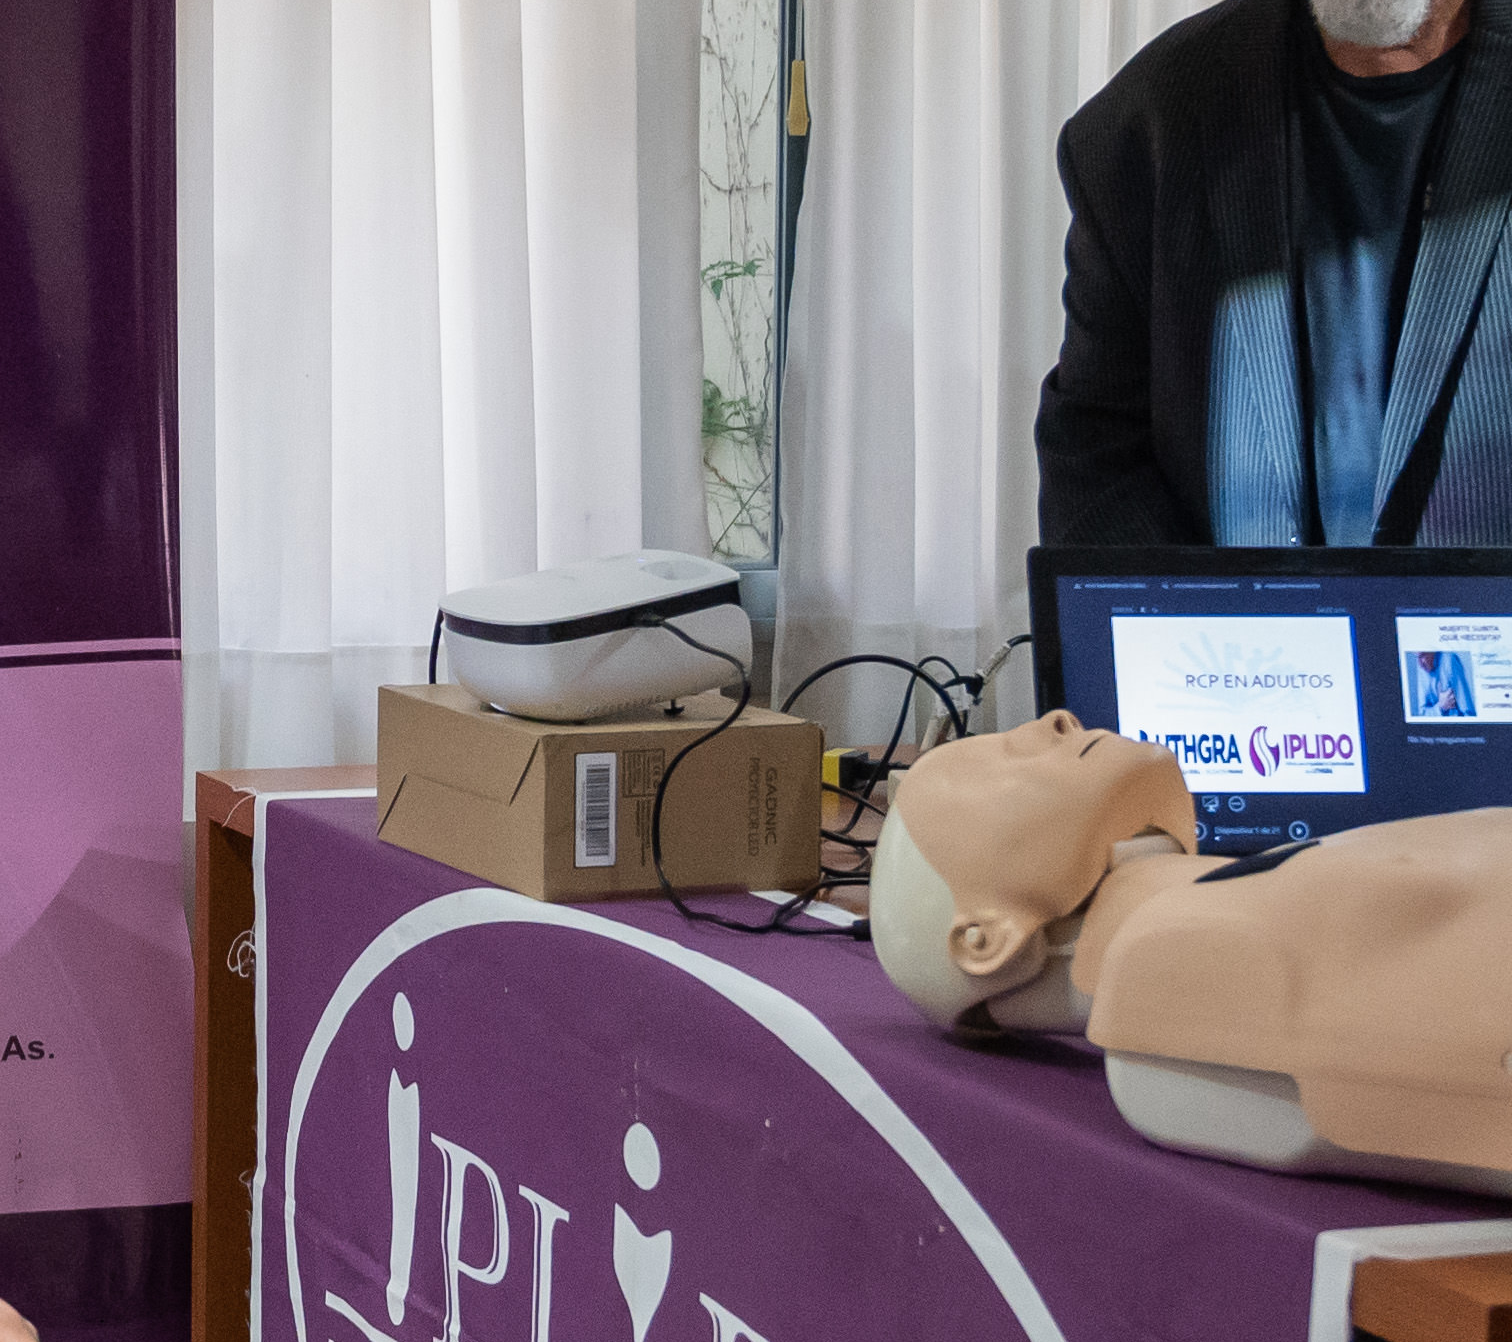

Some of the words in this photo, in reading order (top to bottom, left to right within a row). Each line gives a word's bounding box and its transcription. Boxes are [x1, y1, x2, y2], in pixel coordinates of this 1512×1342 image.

[1185, 674, 1219, 689] RCP
[1222, 674, 1250, 689] EN
[1252, 674, 1334, 689] ADULTOS
[1283, 734, 1354, 760] IPLIDO
[1, 1033, 56, 1062] As.
